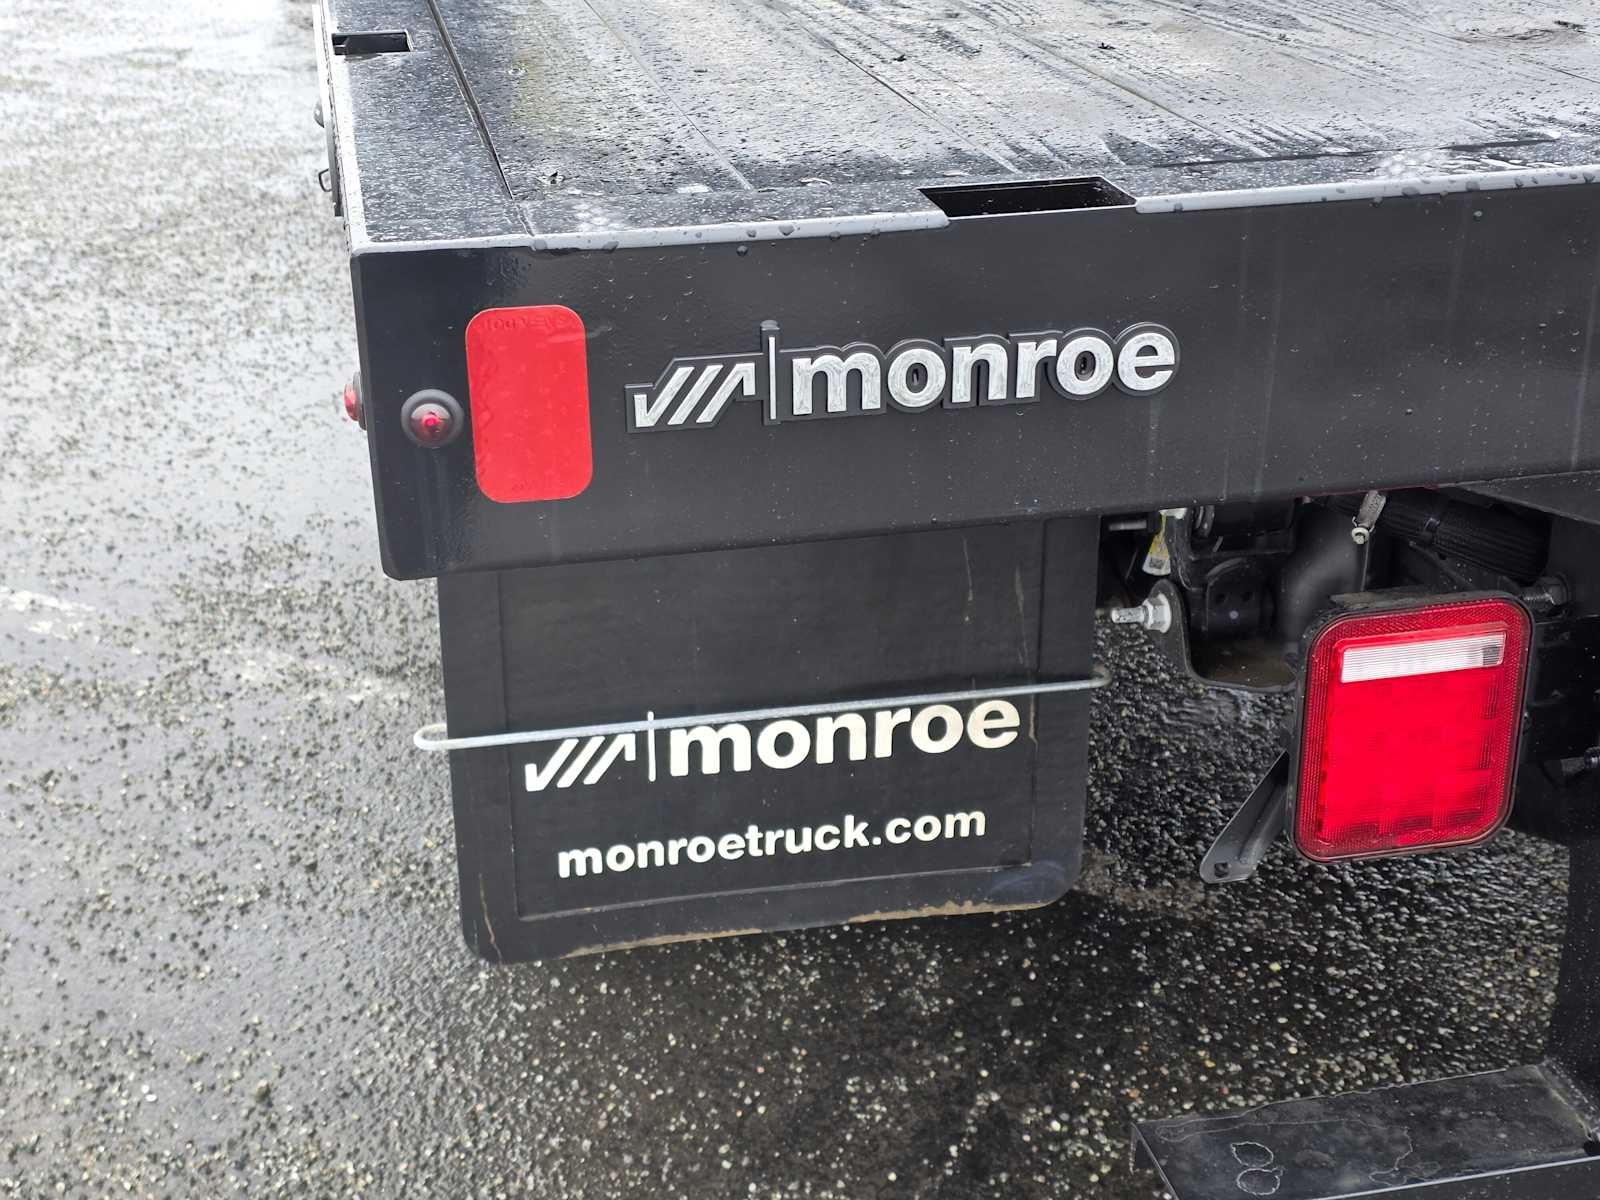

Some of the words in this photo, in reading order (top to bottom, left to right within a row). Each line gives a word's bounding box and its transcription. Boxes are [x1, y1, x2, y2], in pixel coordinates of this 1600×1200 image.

[791, 331, 1177, 416] monroe
[669, 699, 1021, 778] monroe
[556, 809, 988, 880] monroetruck.com
